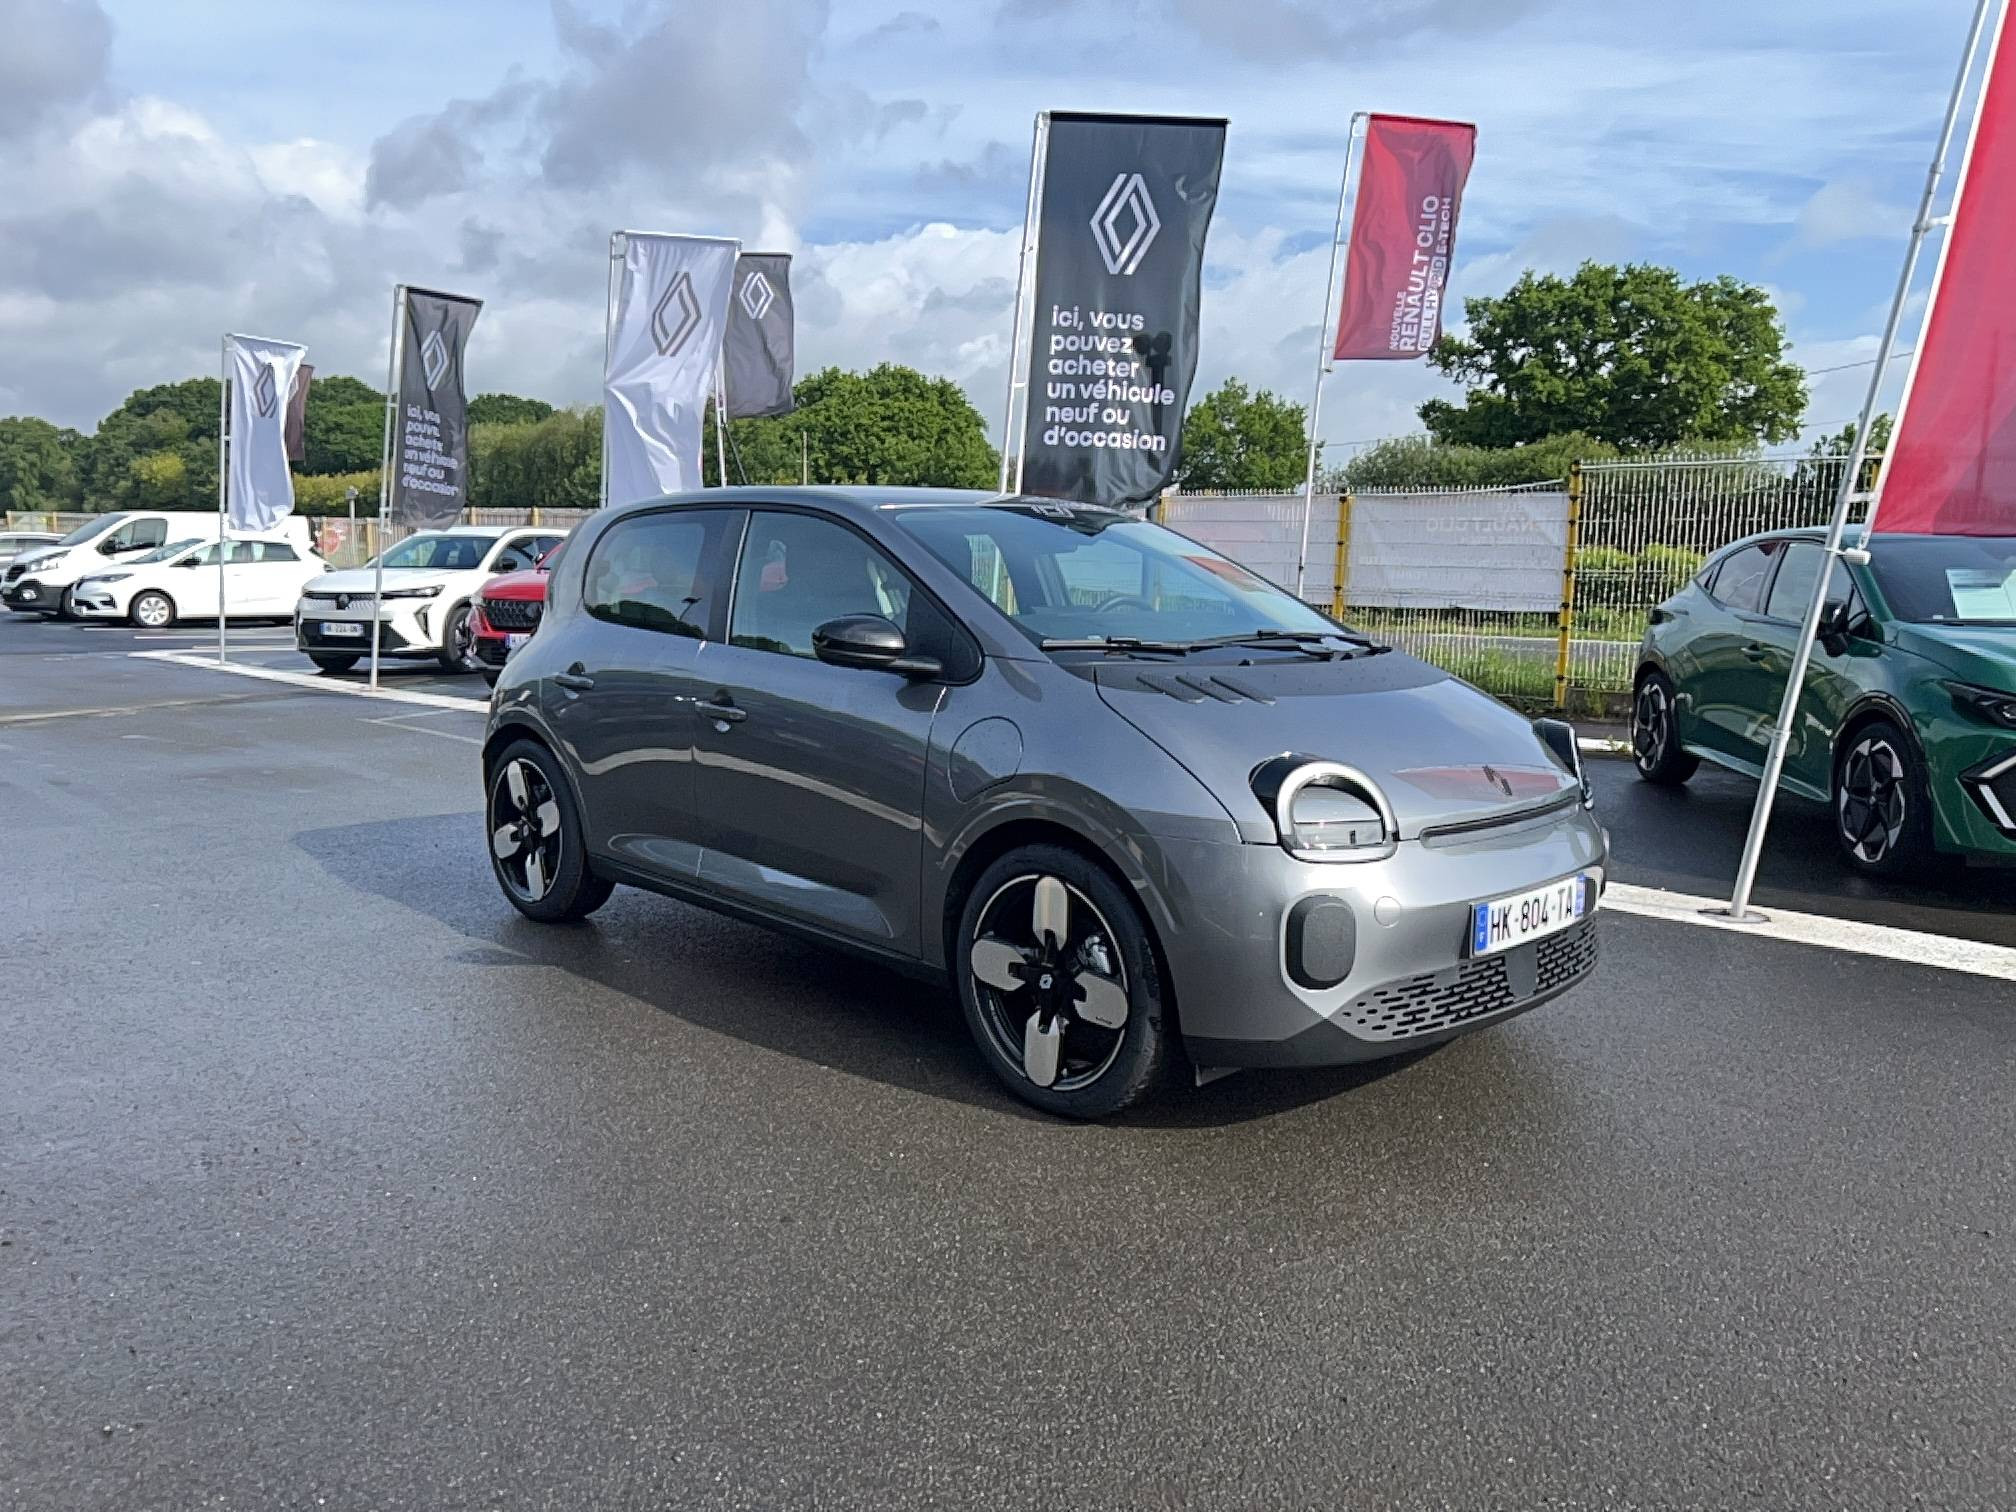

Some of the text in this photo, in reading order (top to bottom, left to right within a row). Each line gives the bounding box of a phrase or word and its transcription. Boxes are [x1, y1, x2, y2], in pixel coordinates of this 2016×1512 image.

[1400, 196, 1440, 351] RENAULT CLIO
[1420, 312, 1436, 349] FULL
[1436, 198, 1452, 254] E-TECH
[1051, 304, 1145, 332] ici, vous
[1389, 291, 1407, 351] NOUVELLE
[1050, 333, 1134, 355] pouvez
[1048, 354, 1140, 378] acheter
[1046, 378, 1176, 406] un véhicule
[1045, 402, 1130, 425] neuf ou
[1043, 424, 1166, 452] d'occasion
